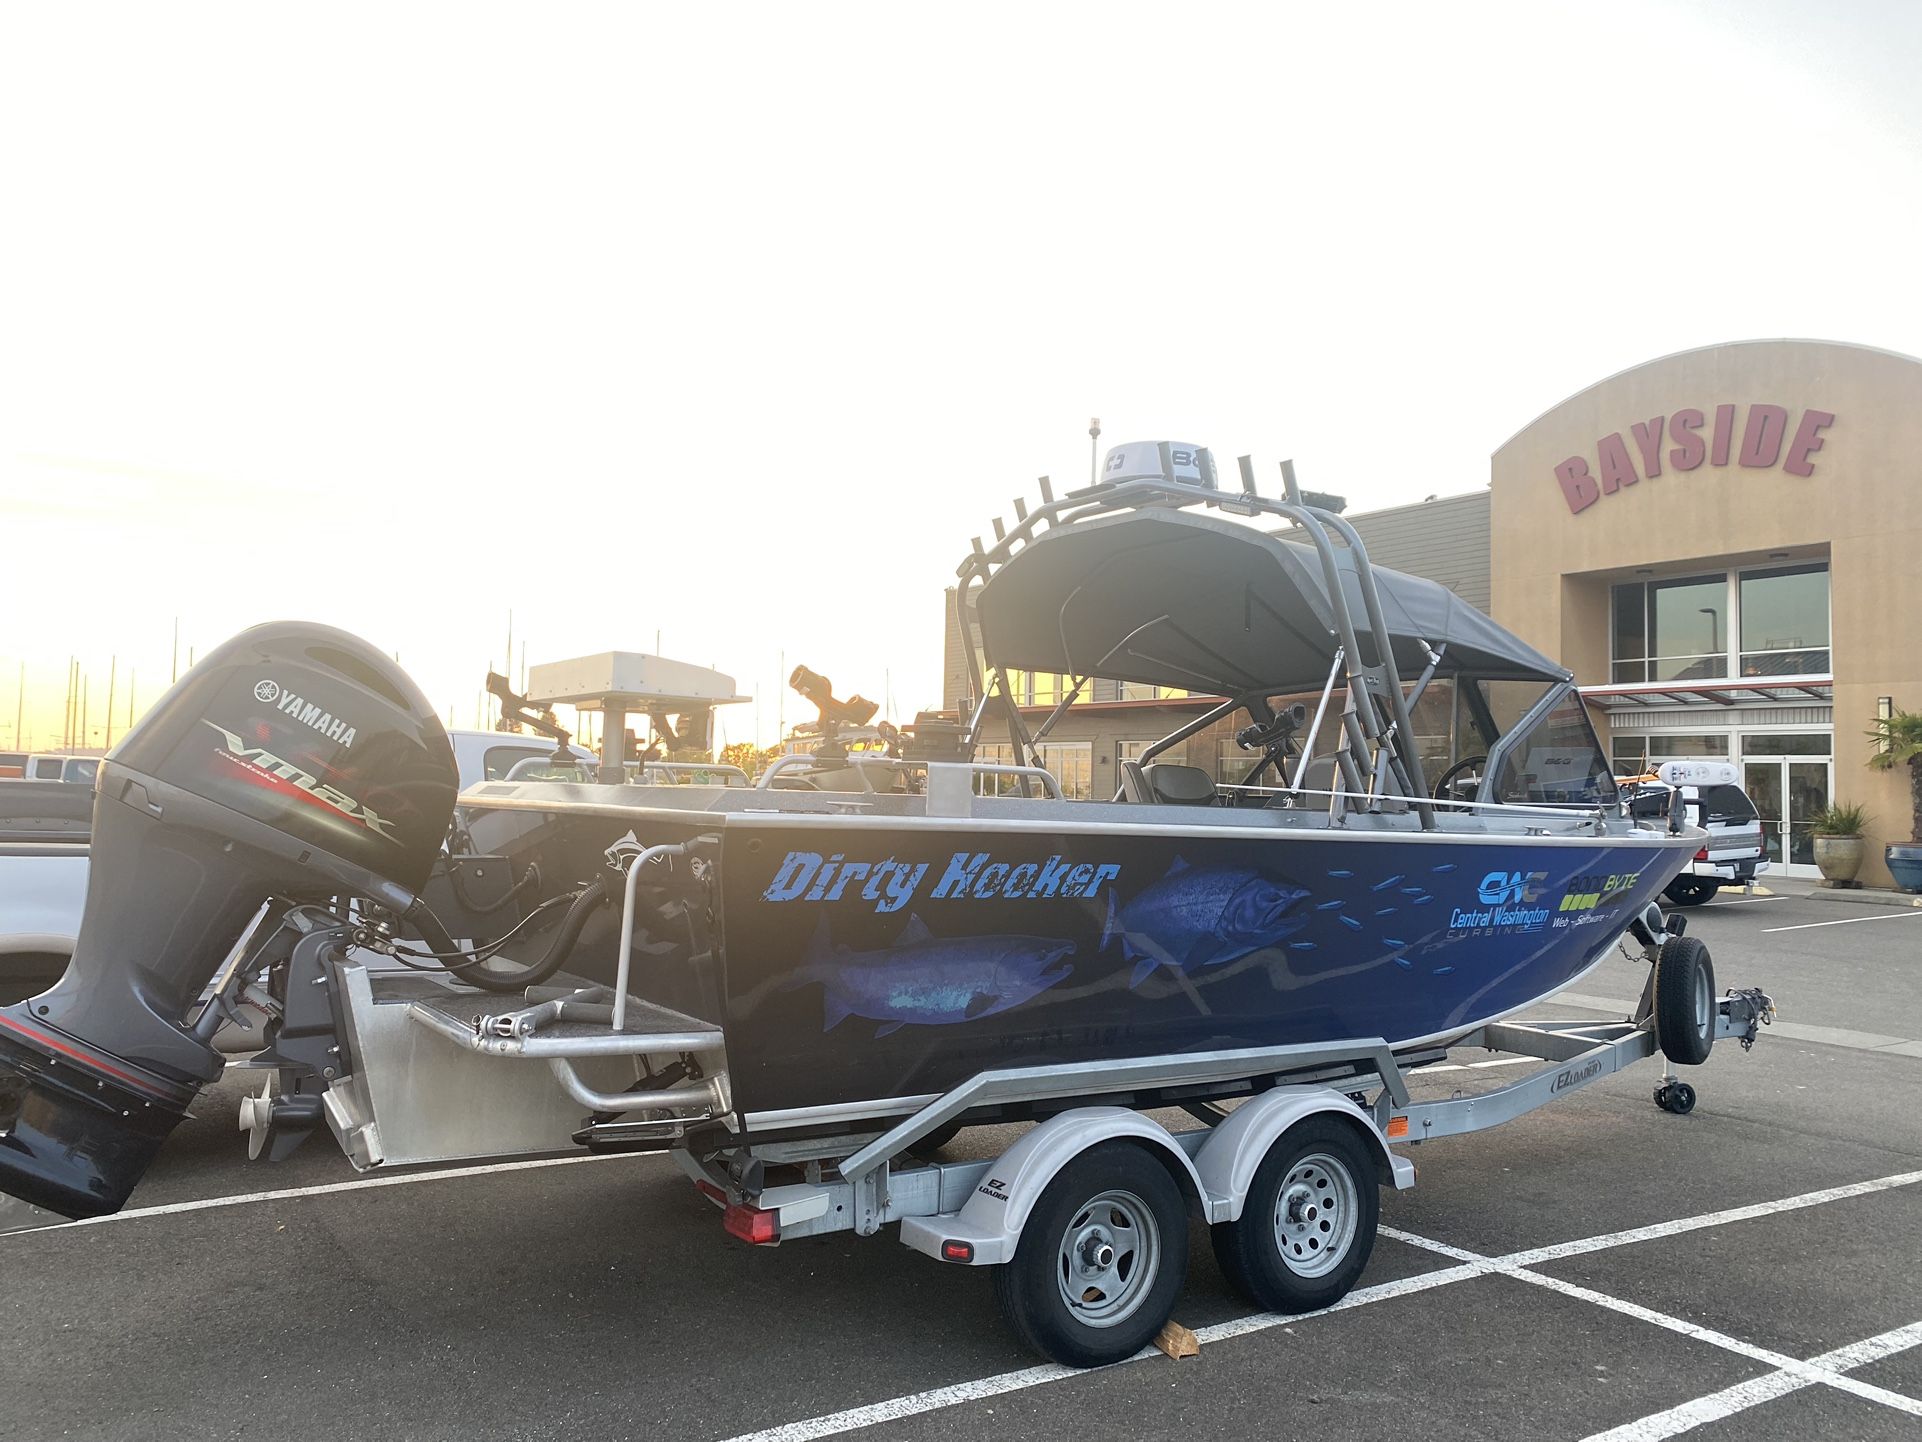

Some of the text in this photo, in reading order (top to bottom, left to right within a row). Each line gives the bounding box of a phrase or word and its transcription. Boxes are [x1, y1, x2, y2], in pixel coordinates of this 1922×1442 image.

[1554, 403, 1835, 515] BAYSIDE
[276, 689, 357, 748] YAMAHA
[758, 851, 1121, 913] Dirty Hooker
[1450, 906, 1550, 928] Central Washington
[1552, 917, 1569, 928] Web
[1575, 914, 1605, 926] Software
[1556, 1063, 1598, 1090] EZ LOADER
[978, 1186, 1009, 1201] LOADER
[988, 1179, 1006, 1190] EZ
